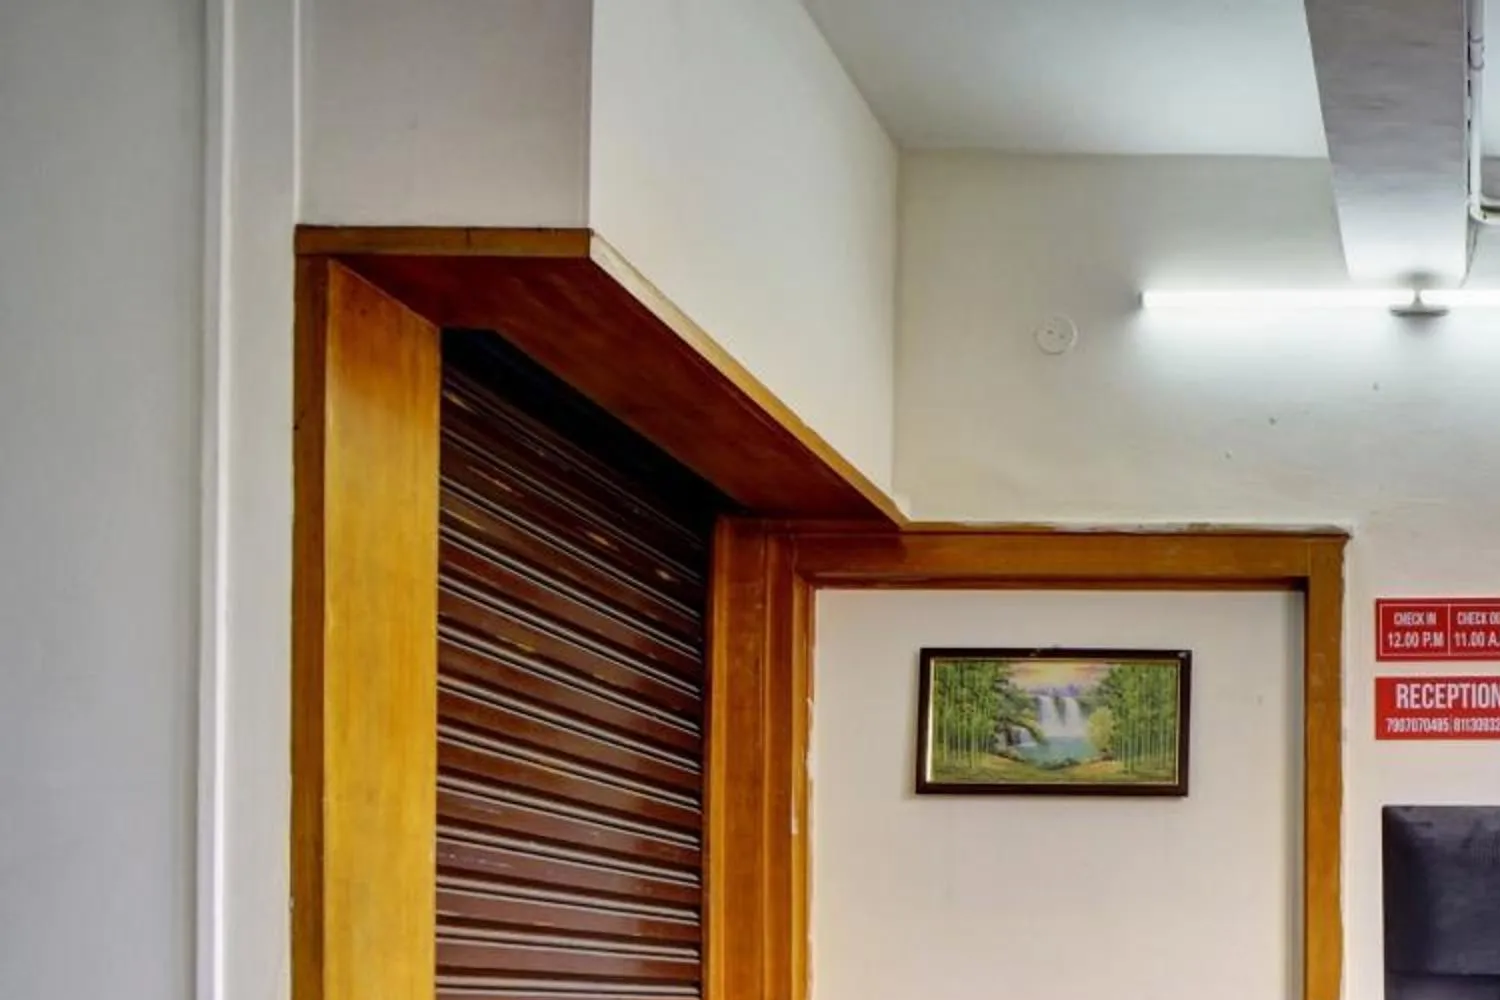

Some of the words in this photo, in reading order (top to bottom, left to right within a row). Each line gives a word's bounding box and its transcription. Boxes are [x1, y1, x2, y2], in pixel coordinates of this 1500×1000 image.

[1393, 611, 1424, 625] CHECK
[1426, 611, 1437, 625] IN
[1457, 611, 1488, 625] CHECK
[1388, 631, 1419, 648] 12.00
[1454, 631, 1485, 647] 11.00
